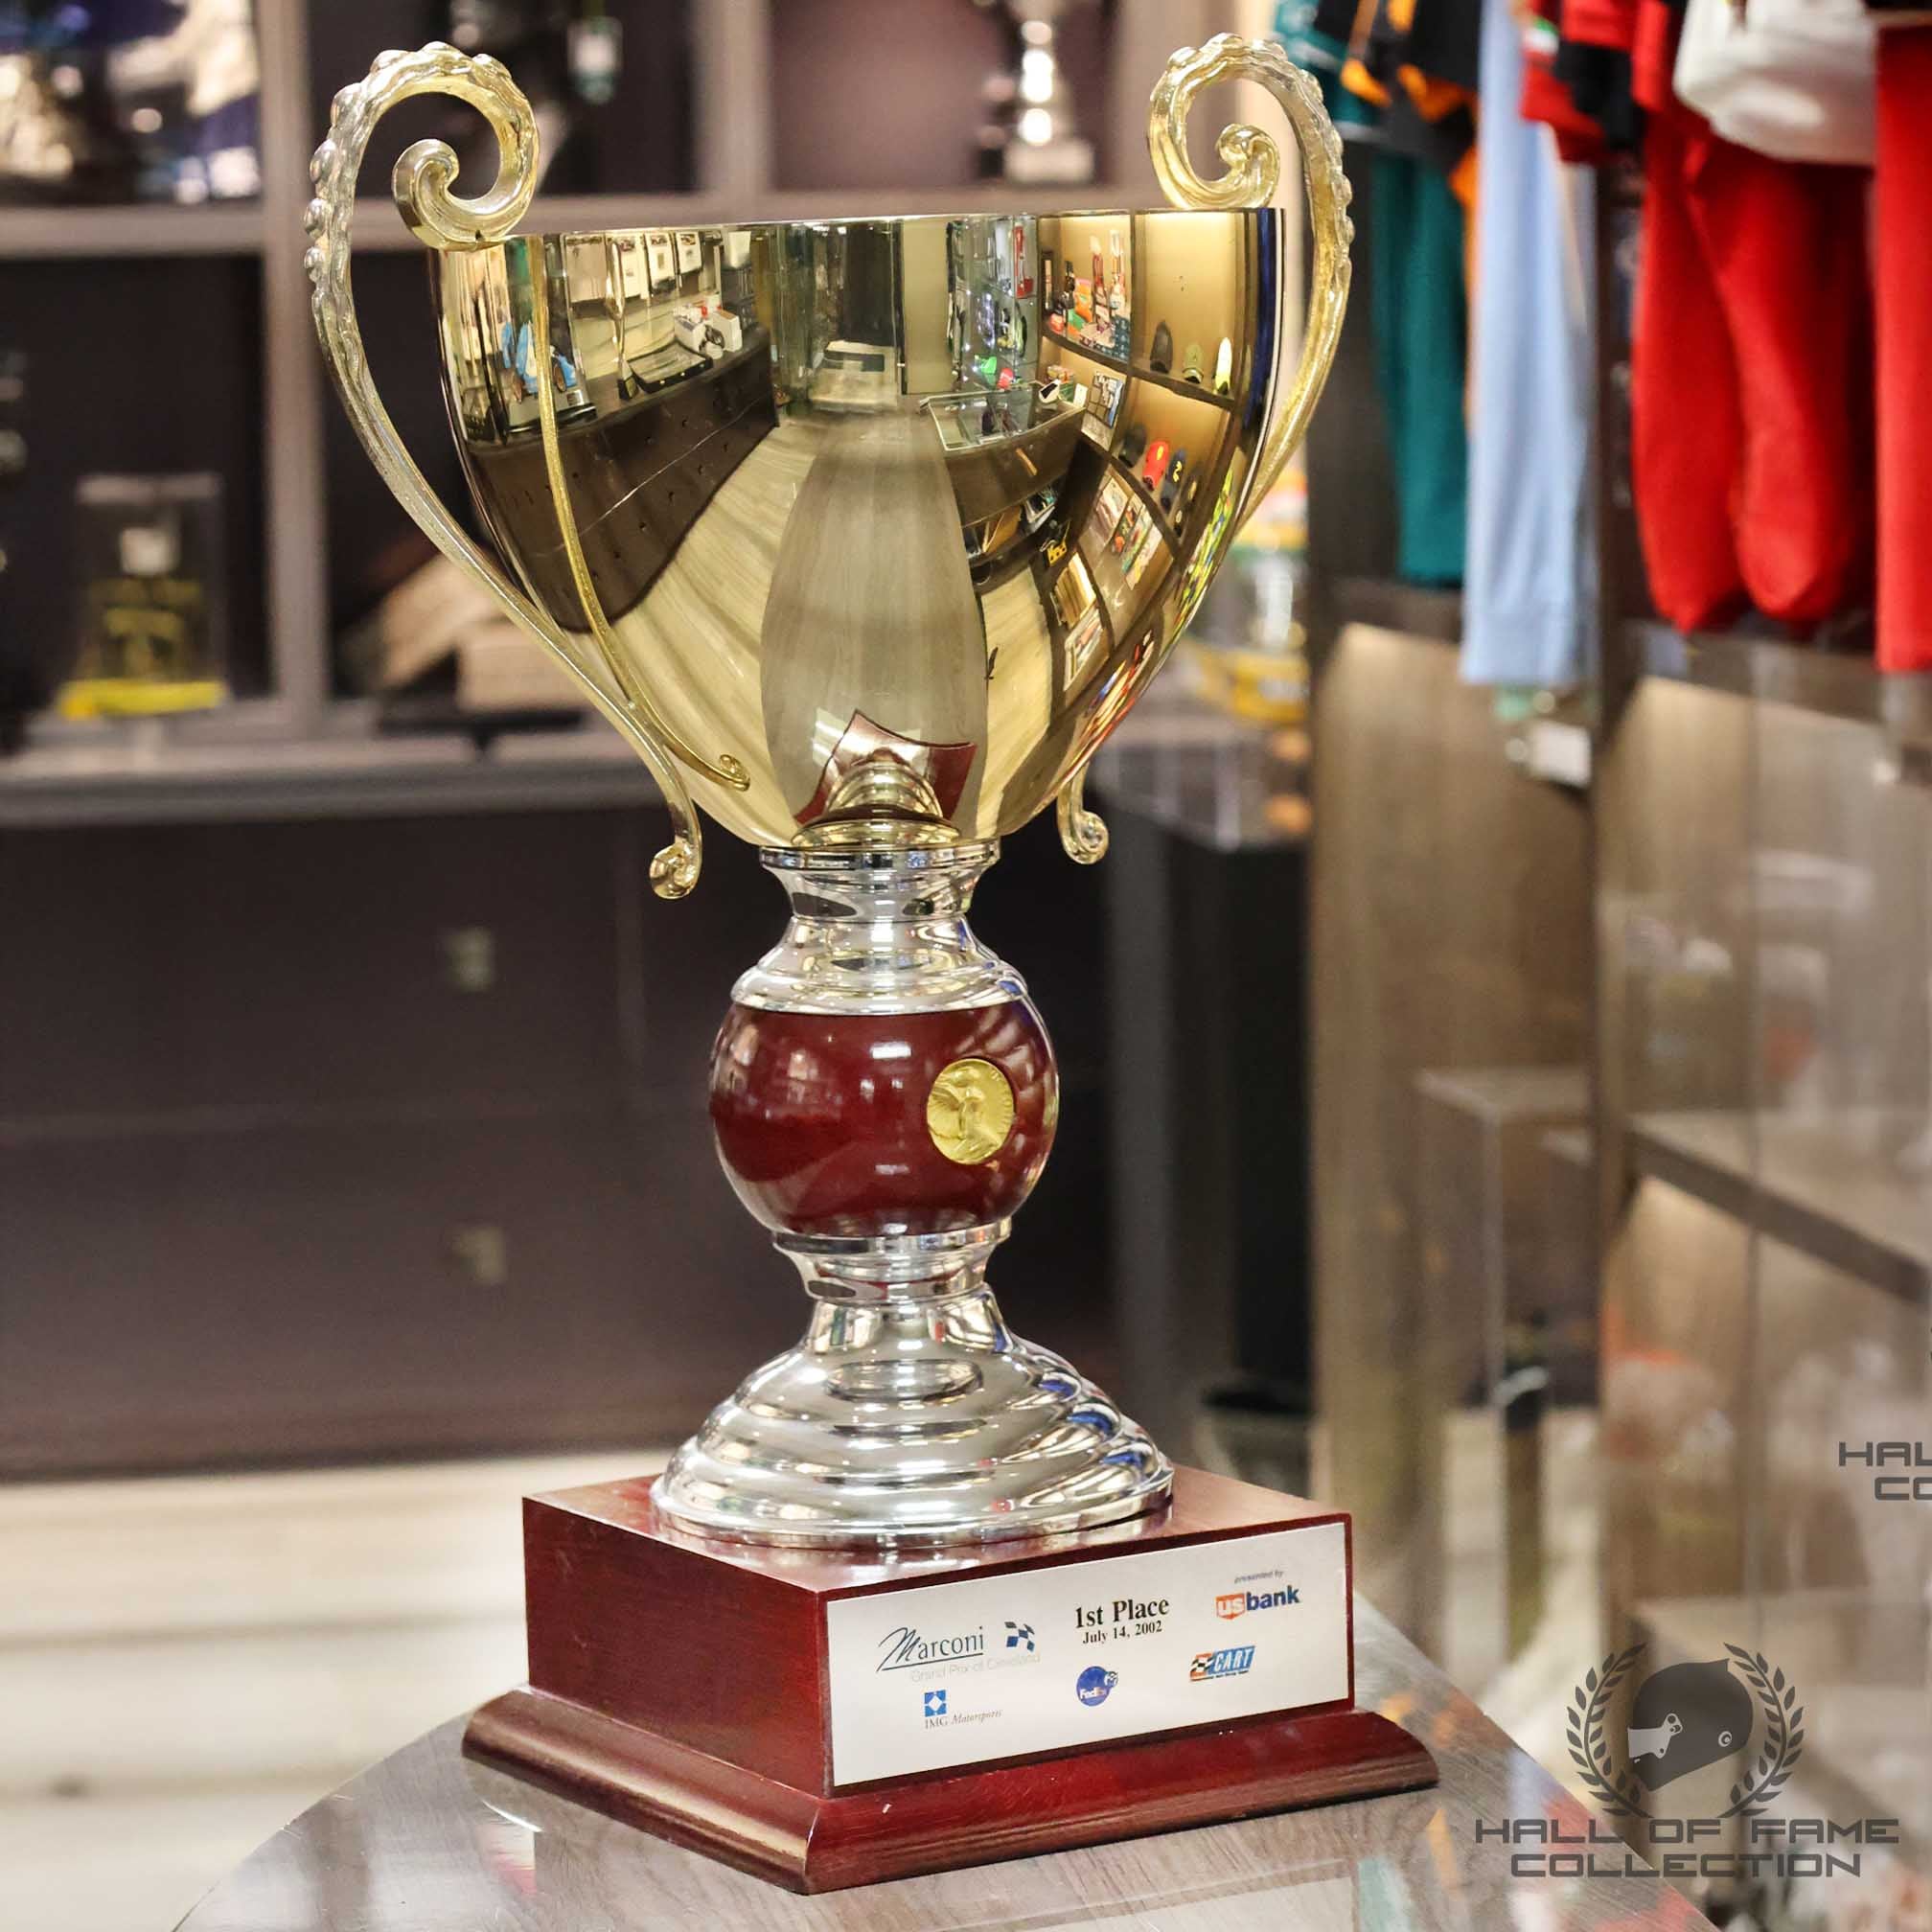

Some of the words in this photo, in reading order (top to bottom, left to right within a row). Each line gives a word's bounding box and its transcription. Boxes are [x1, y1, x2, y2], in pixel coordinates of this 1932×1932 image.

[1075, 1605, 1103, 1628] 1st
[1113, 1598, 1169, 1622] Place
[1082, 1630, 1108, 1644] July
[1113, 1625, 1130, 1640] 14,
[1135, 1620, 1162, 1635] 2002
[877, 1625, 984, 1671] Marconi
[1212, 1648, 1253, 1672] CART
[911, 1664, 946, 1683] Grand
[925, 1716, 949, 1730] IMG
[951, 1710, 1002, 1725] Motorsports
